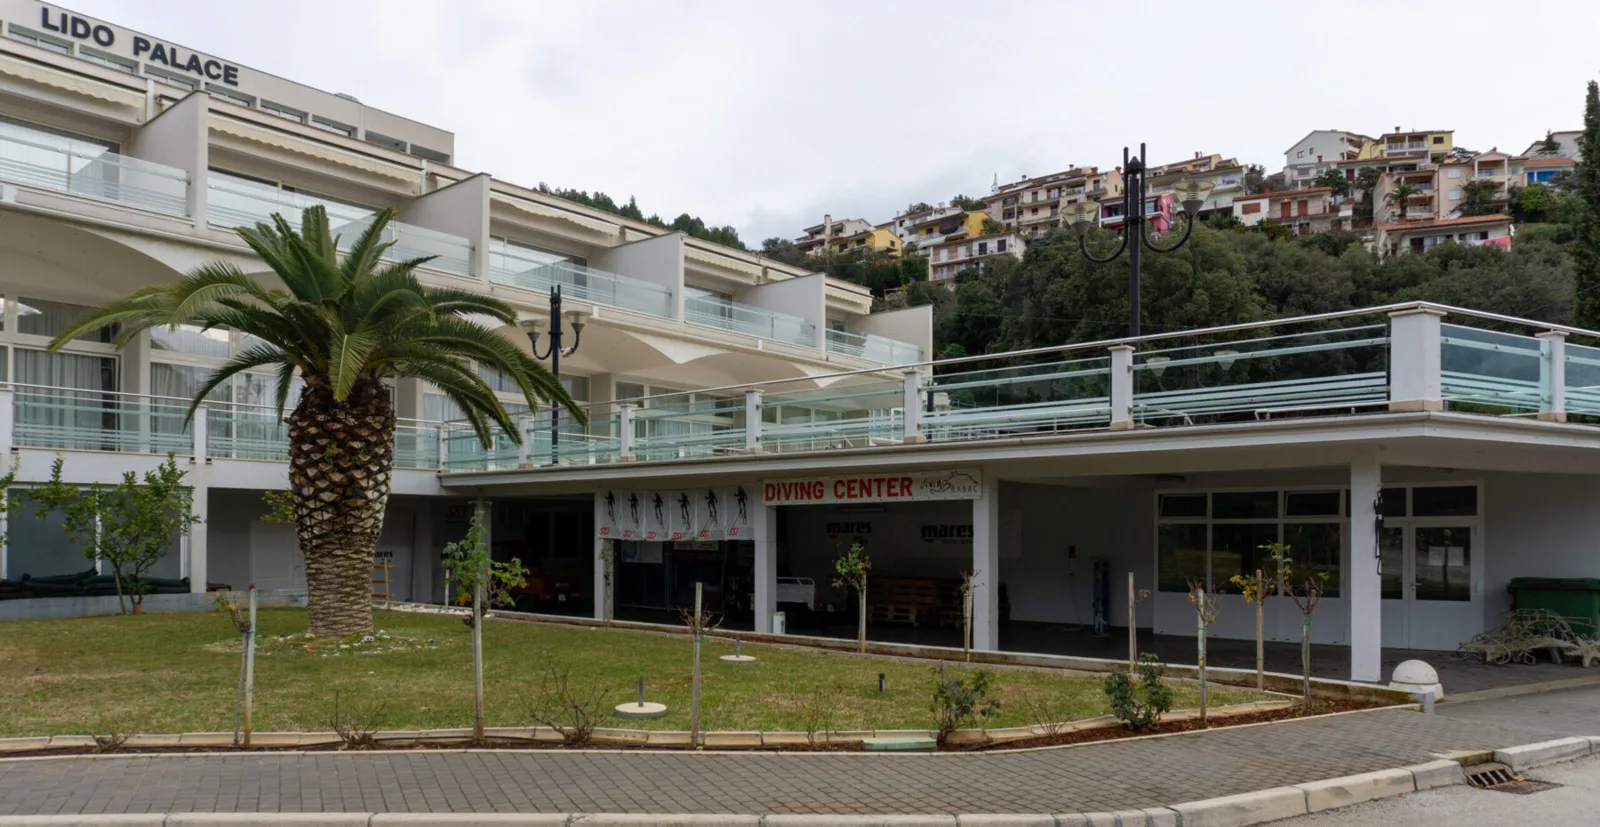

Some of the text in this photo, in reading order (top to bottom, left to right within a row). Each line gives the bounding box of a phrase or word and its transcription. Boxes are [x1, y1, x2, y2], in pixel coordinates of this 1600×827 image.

[41, 6, 239, 86] LIDO PALACE
[765, 477, 913, 501] DIVING CENTER
[826, 521, 872, 534] mares
